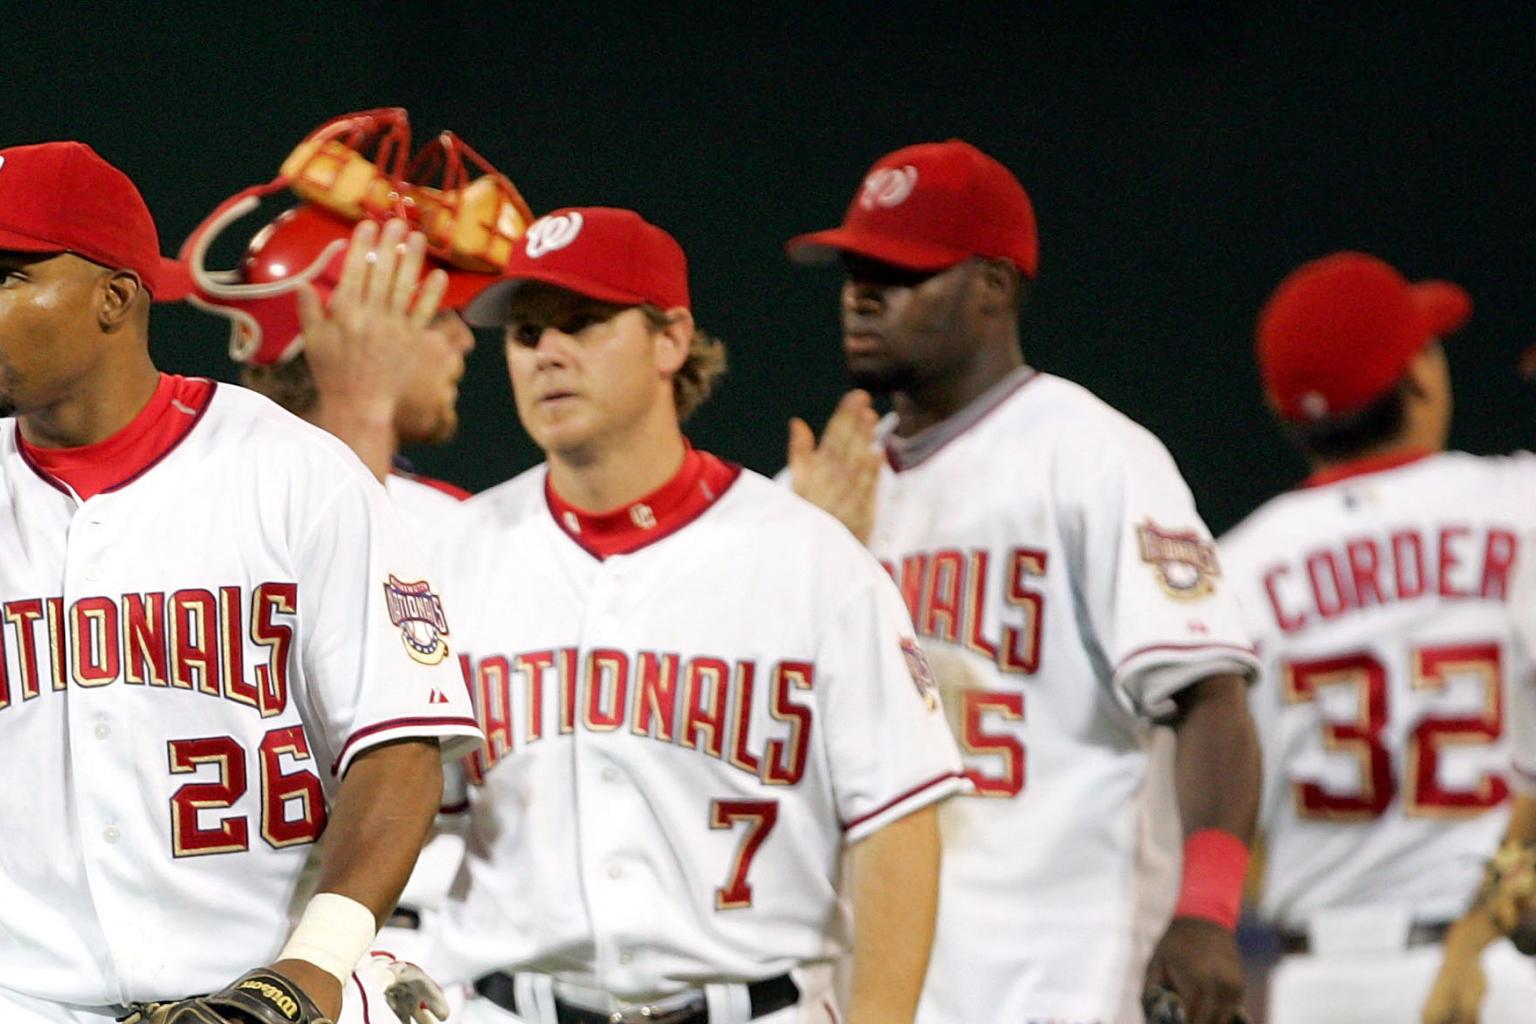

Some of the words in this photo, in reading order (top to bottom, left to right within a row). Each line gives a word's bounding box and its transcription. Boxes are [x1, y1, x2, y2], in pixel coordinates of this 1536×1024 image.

[167, 725, 328, 859] 26
[1279, 644, 1509, 819] 32
[709, 797, 780, 911] 7
